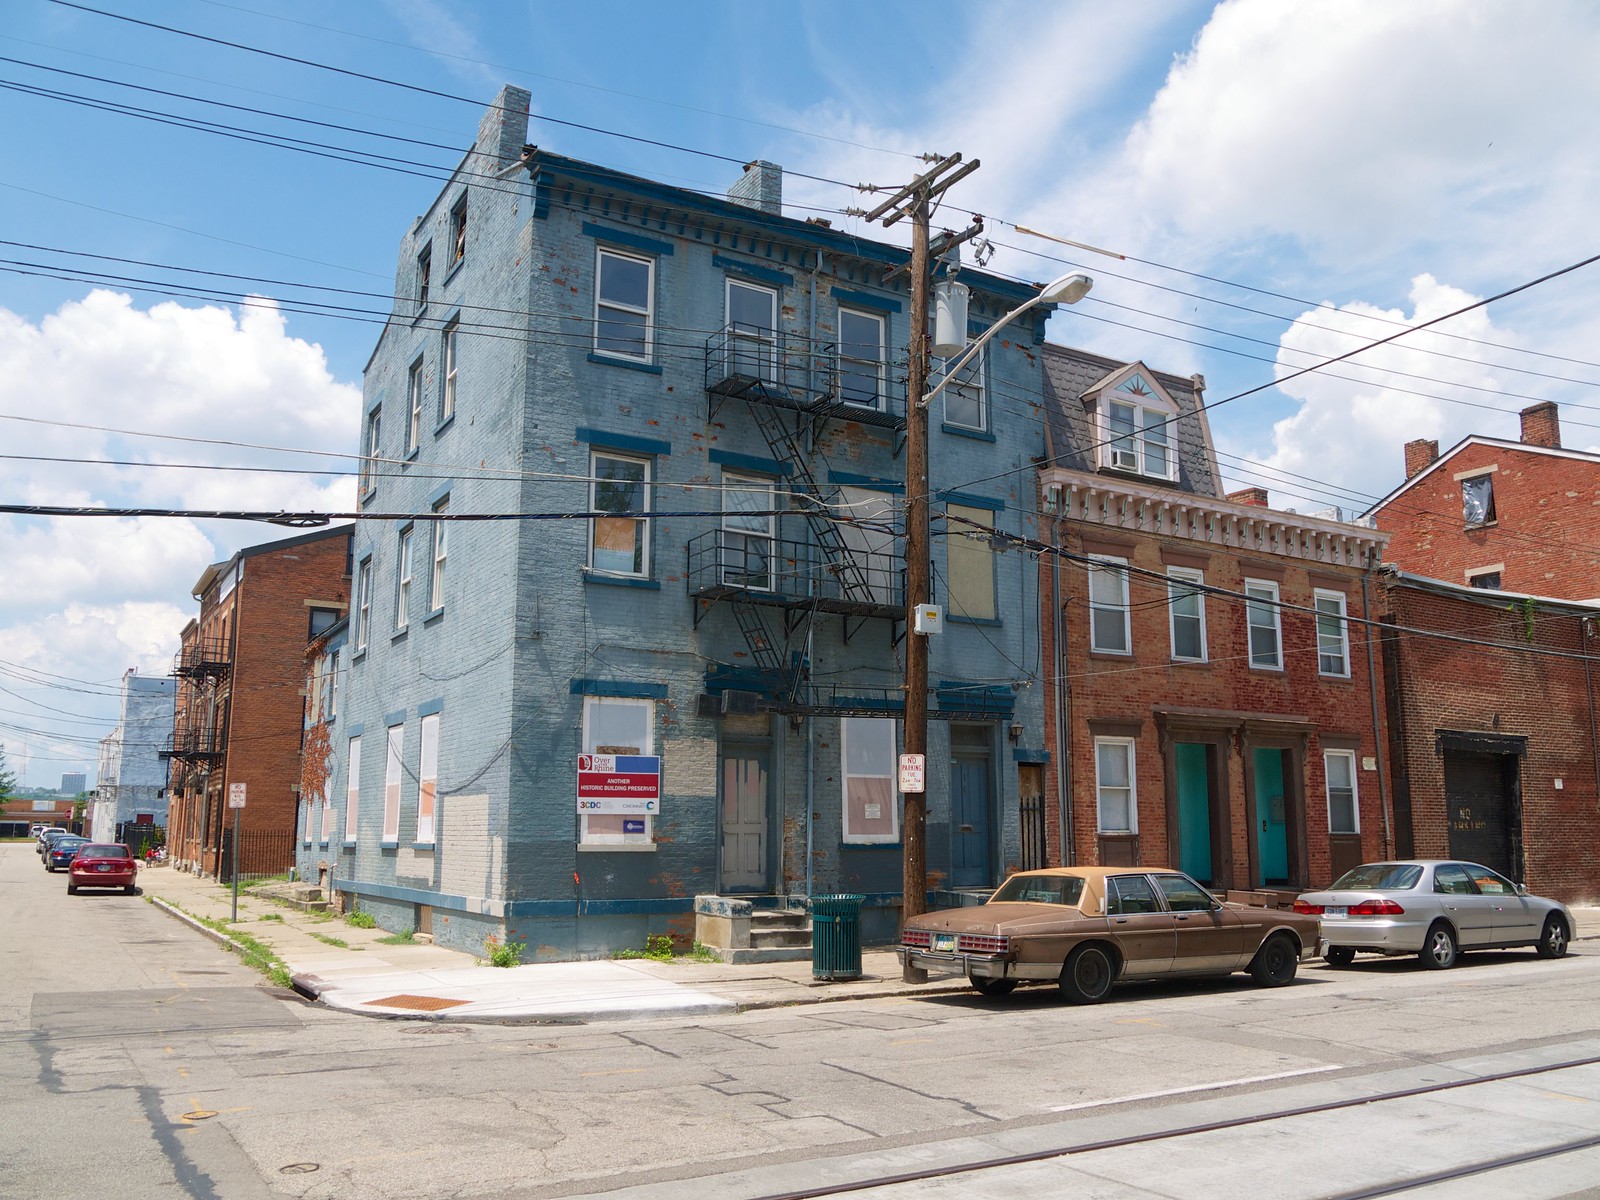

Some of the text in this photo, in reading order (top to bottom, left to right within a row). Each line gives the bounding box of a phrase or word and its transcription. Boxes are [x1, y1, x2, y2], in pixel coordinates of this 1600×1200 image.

[594, 756, 611, 764] Over
[594, 764, 614, 772] Rhine
[580, 801, 602, 809] 3CDC
[1459, 807, 1471, 820] NO
